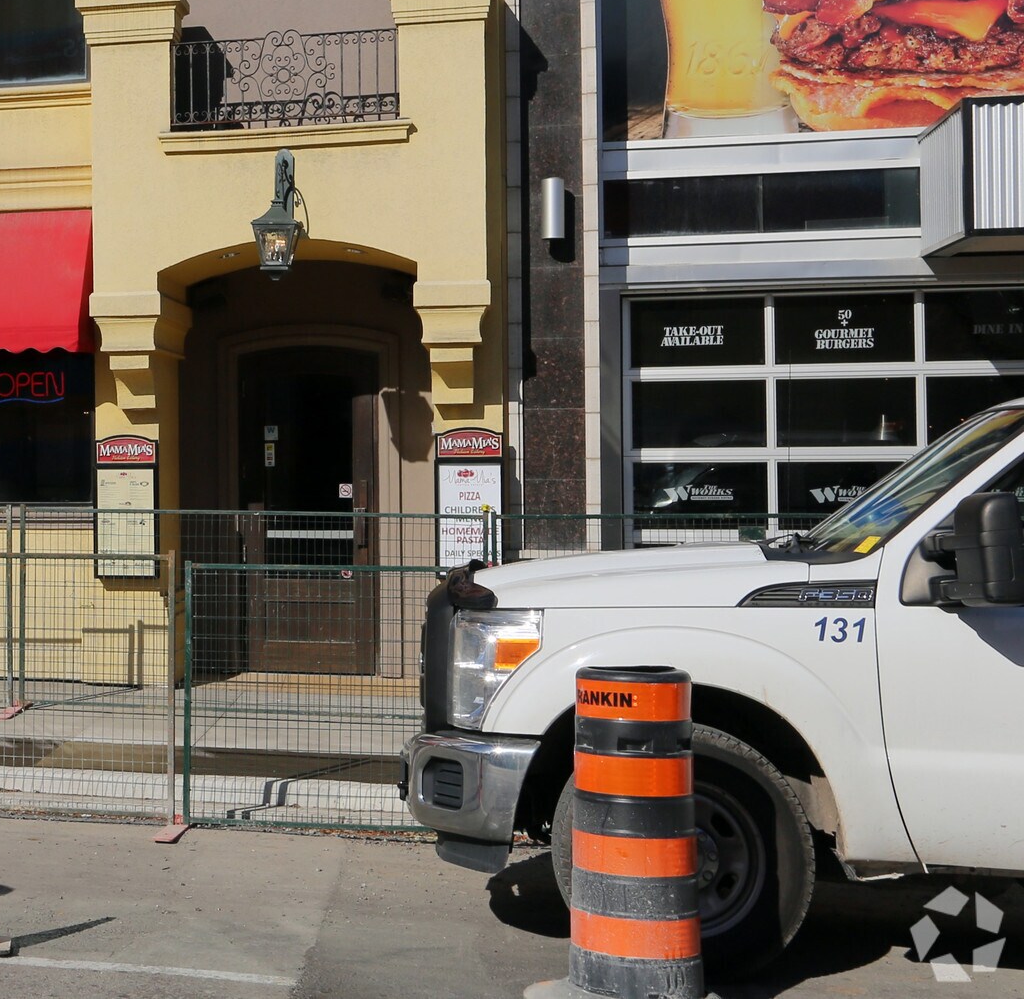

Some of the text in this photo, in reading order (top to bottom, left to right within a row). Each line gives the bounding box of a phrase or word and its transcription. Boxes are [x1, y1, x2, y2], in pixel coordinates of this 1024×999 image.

[837, 309, 852, 320] 50
[663, 325, 724, 337] TAKE-OUT
[814, 327, 874, 339] GOURMET
[973, 323, 1004, 335] DINE
[660, 335, 724, 347] AVAILABLE
[815, 338, 874, 350] BURGERS
[458, 491, 481, 501] PIZZA
[691, 487, 734, 496] WORKS
[456, 536, 484, 544] PASTA
[444, 549, 466, 557] DAILY
[814, 616, 866, 643] 131
[576, 688, 633, 708] RANKIN
